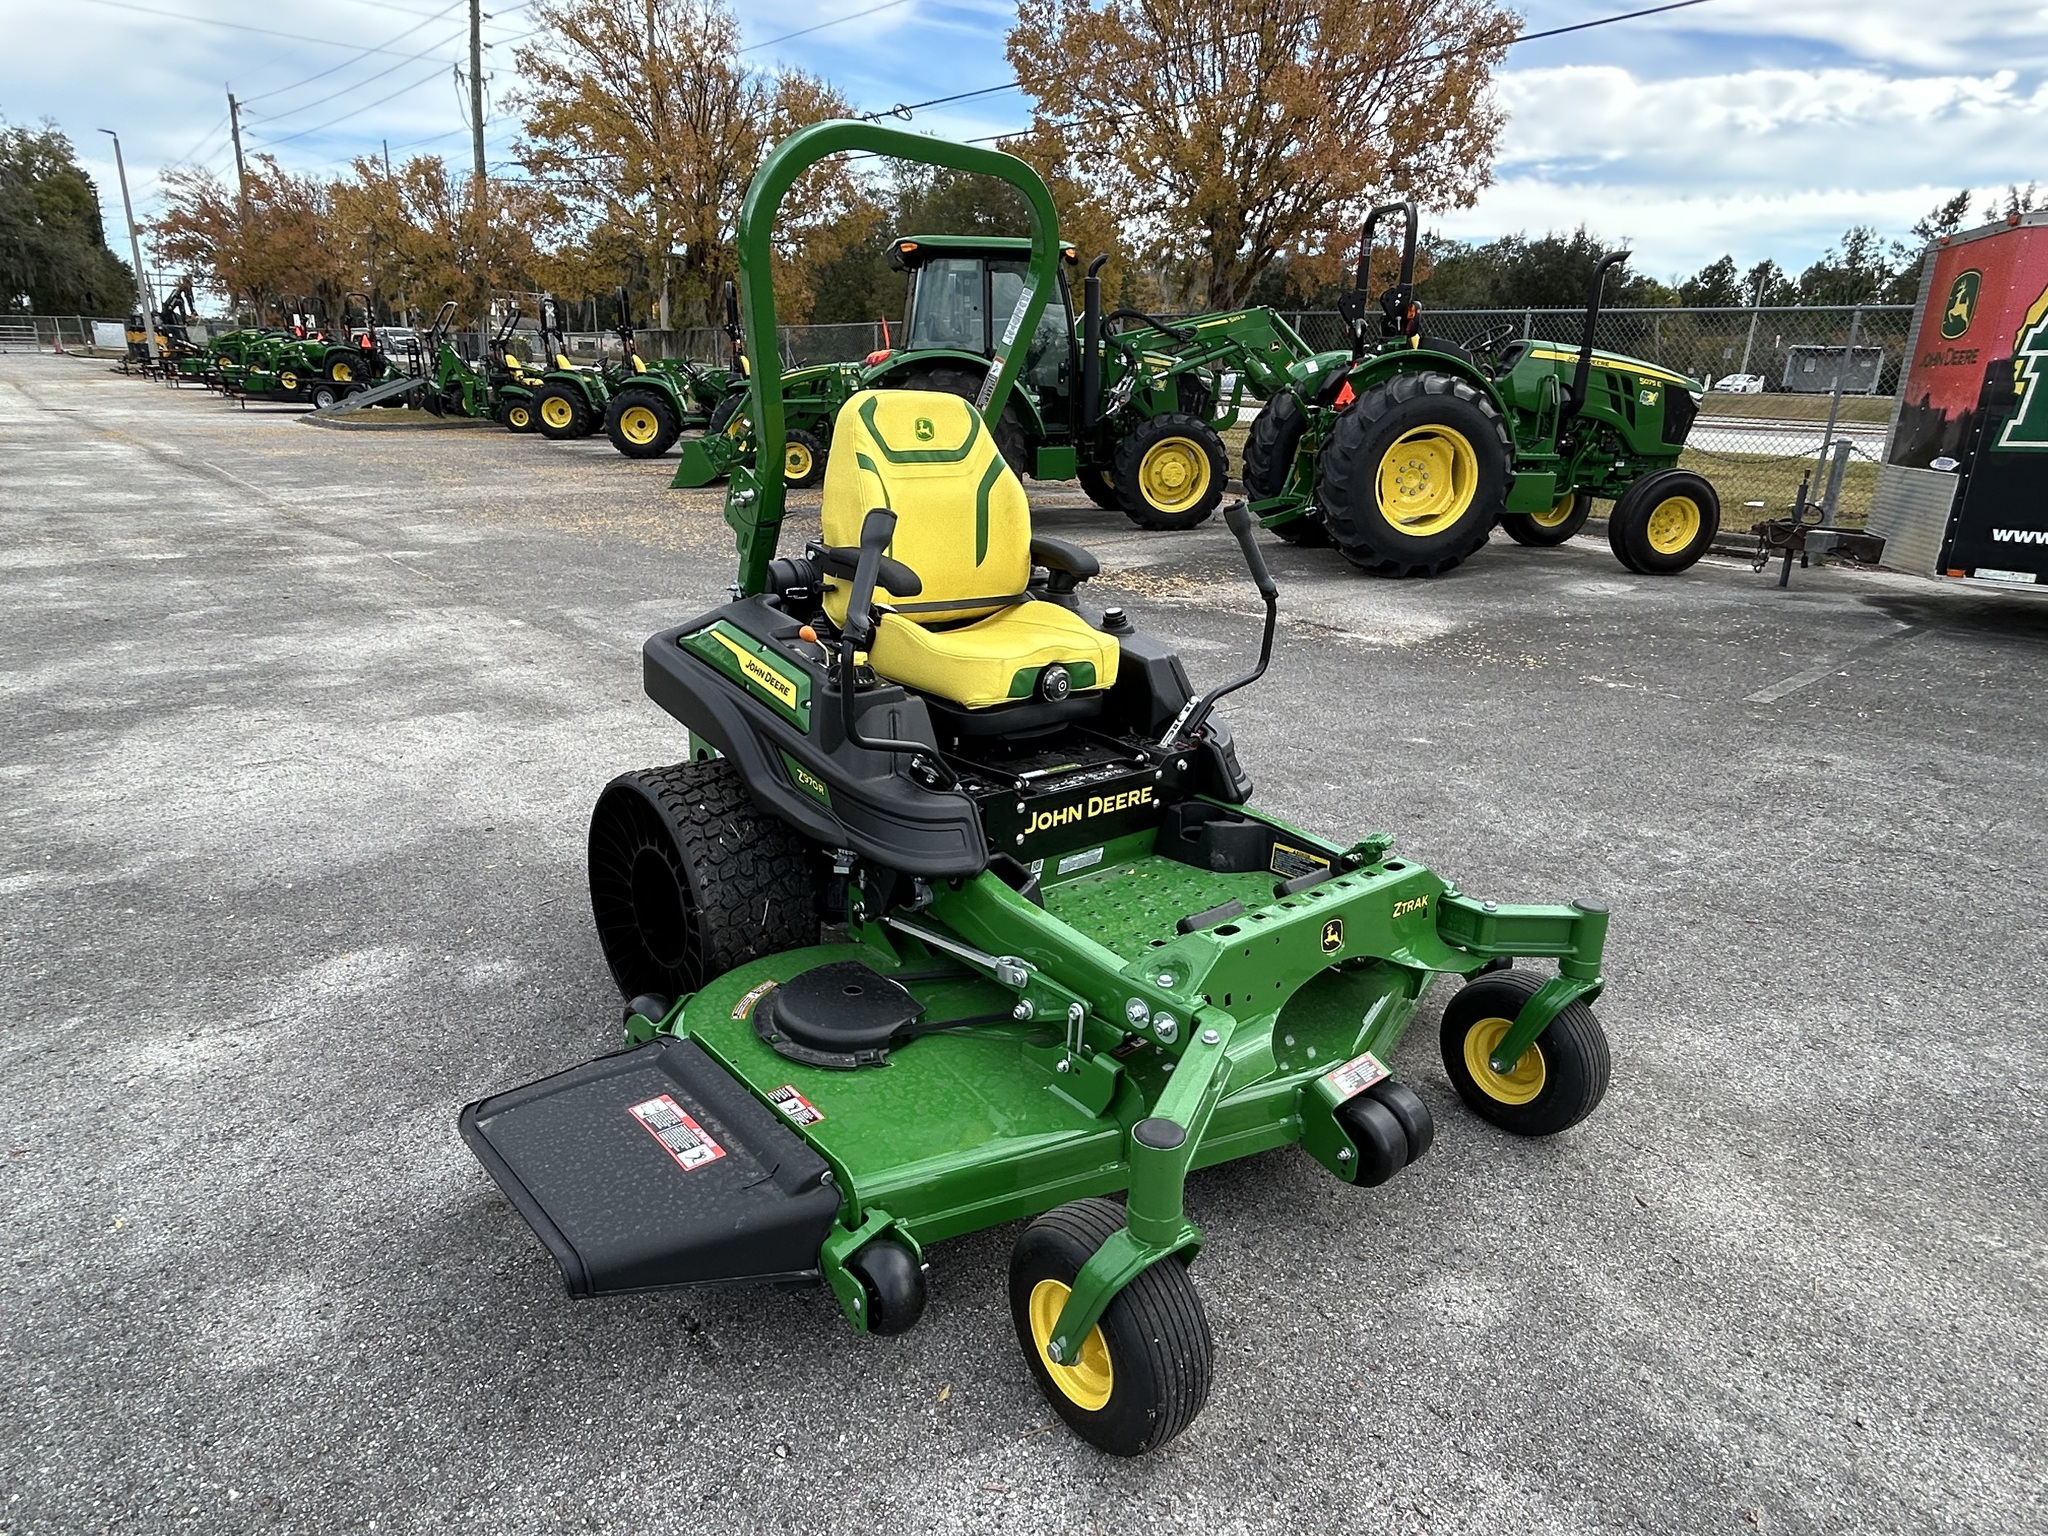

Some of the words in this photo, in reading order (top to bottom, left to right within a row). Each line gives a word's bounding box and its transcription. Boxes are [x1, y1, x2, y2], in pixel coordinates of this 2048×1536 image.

[1944, 347, 1980, 366] DEERE
[745, 659, 766, 679] JOHN
[764, 671, 791, 697] DEERE
[796, 768, 825, 796] Z970R
[1024, 803, 1083, 835] JOHN
[1087, 786, 1153, 818] DEERE
[1392, 894, 1429, 918] ZTRAK
